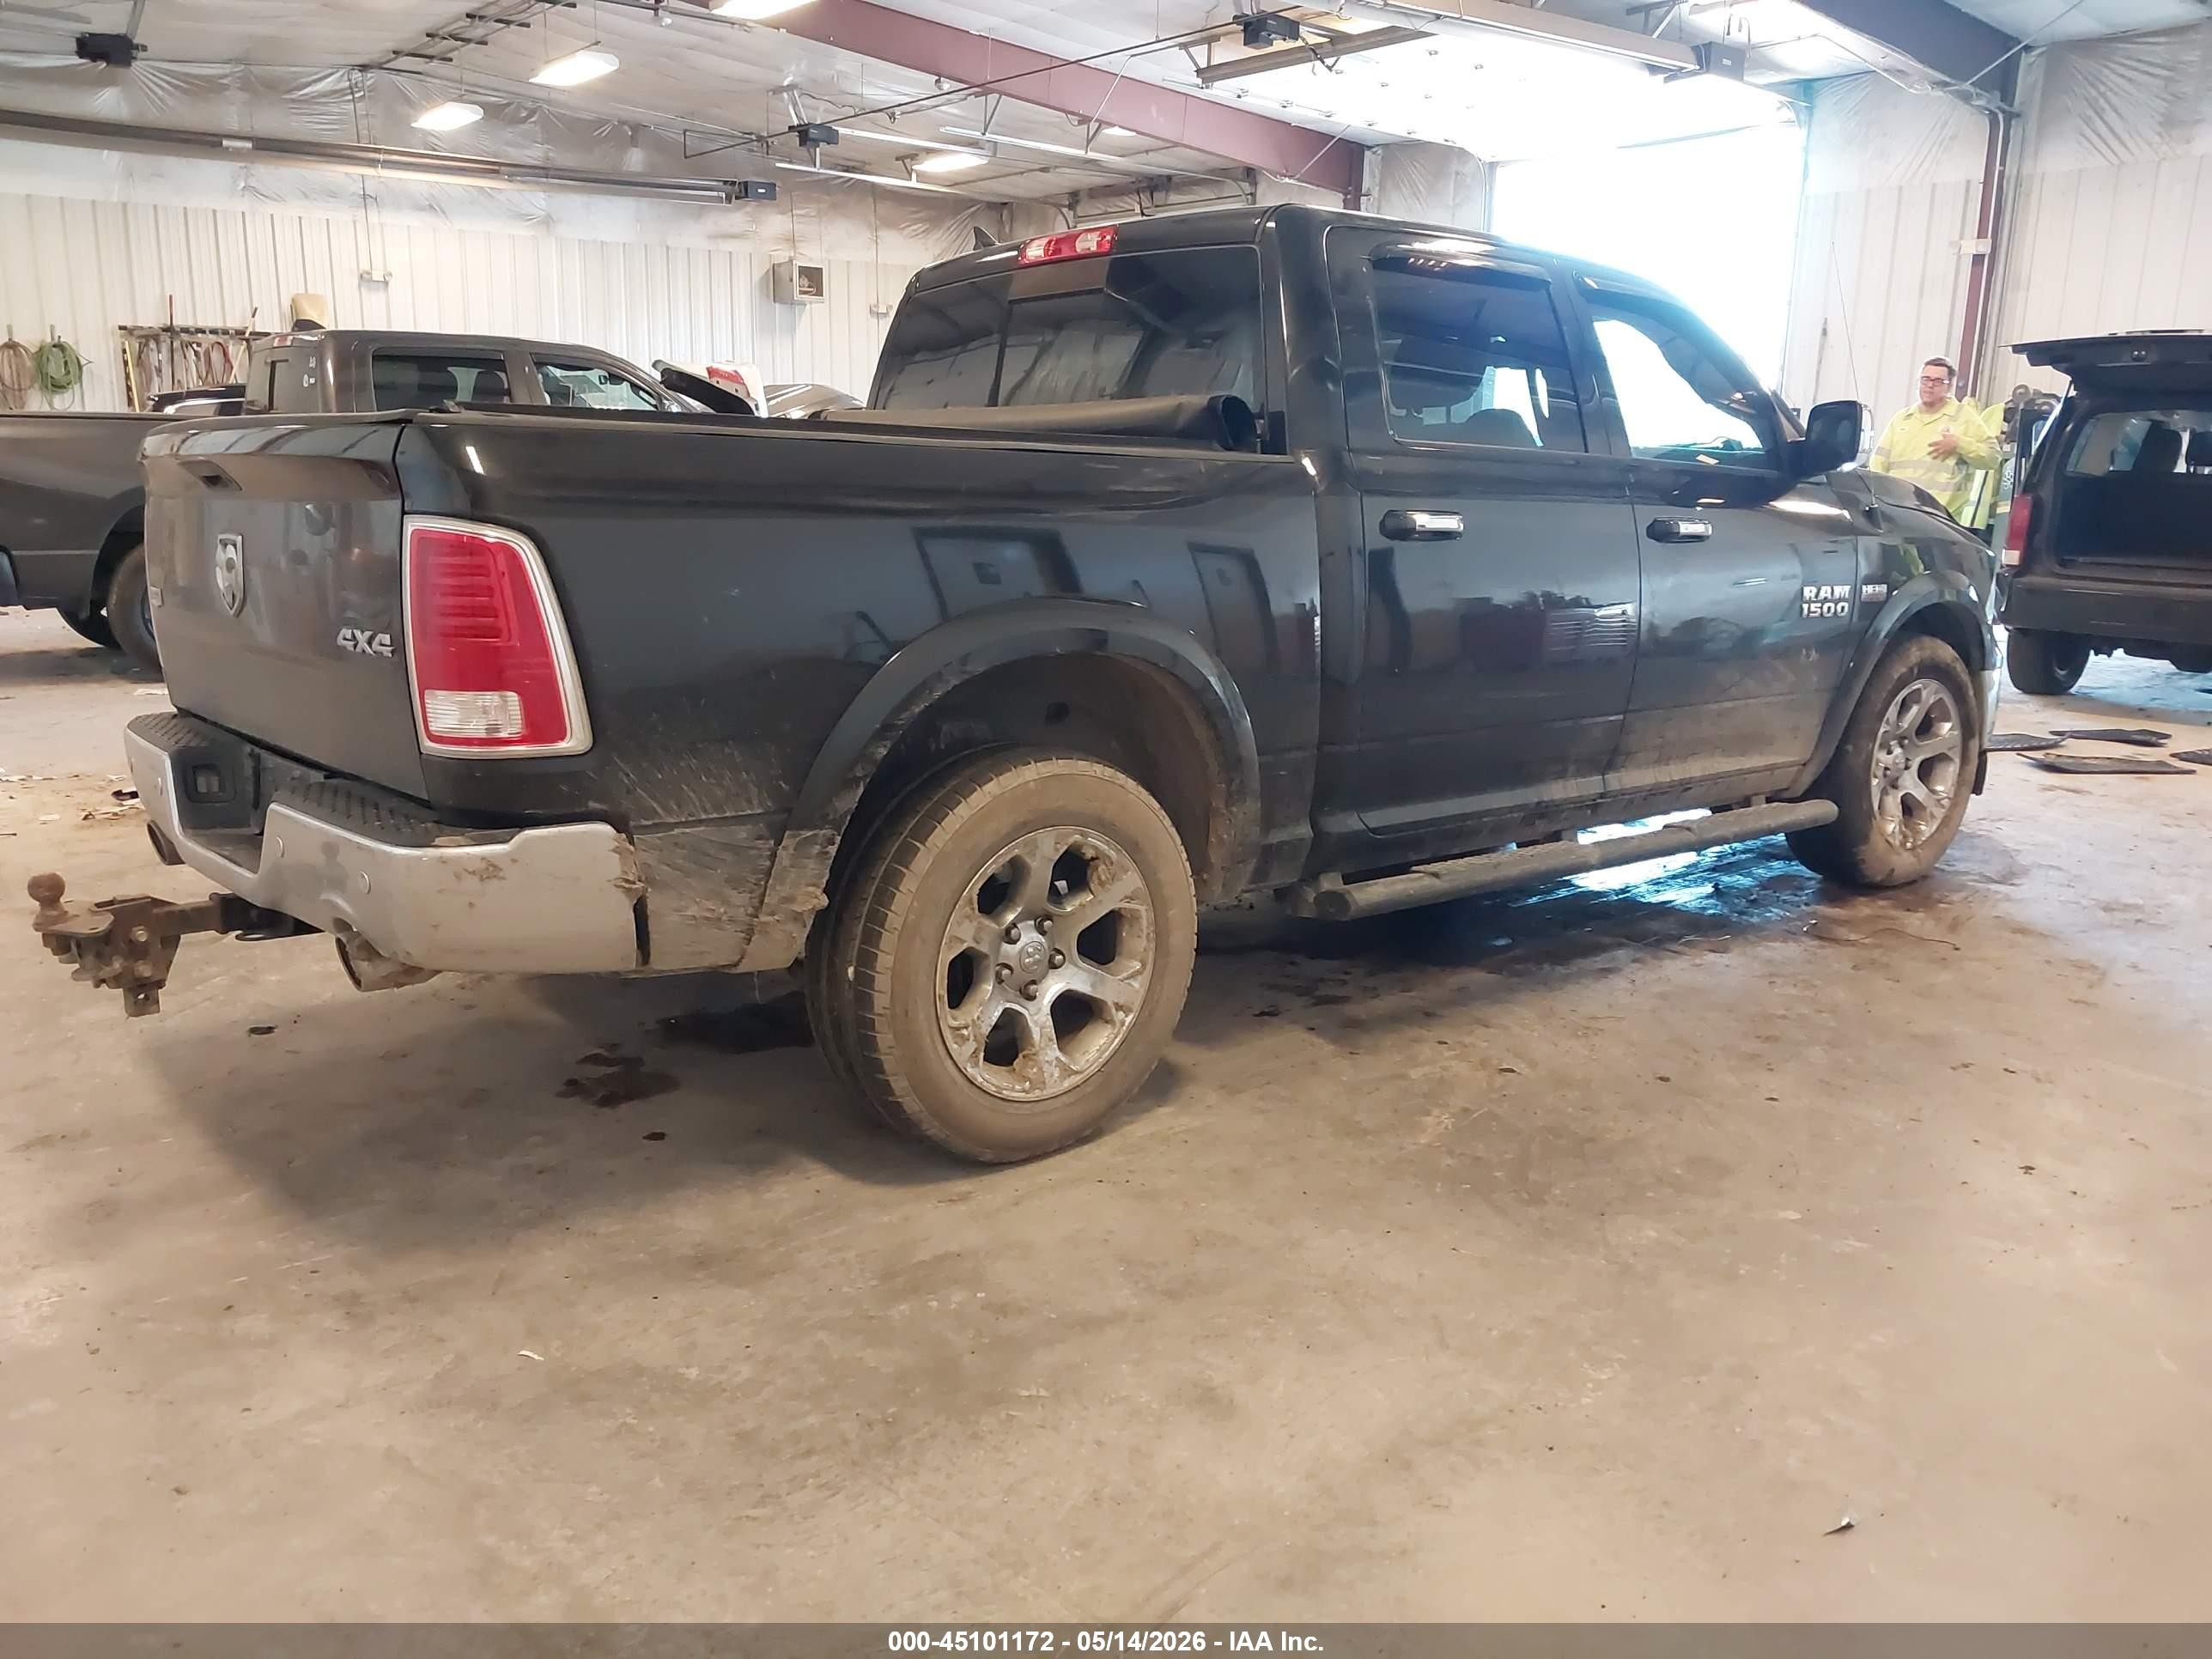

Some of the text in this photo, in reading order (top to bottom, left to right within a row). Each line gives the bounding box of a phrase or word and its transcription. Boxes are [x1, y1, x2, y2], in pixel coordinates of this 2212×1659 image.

[1802, 585, 1851, 601] RAM
[1802, 602, 1849, 618] 1500
[337, 628, 395, 658] 4X4
